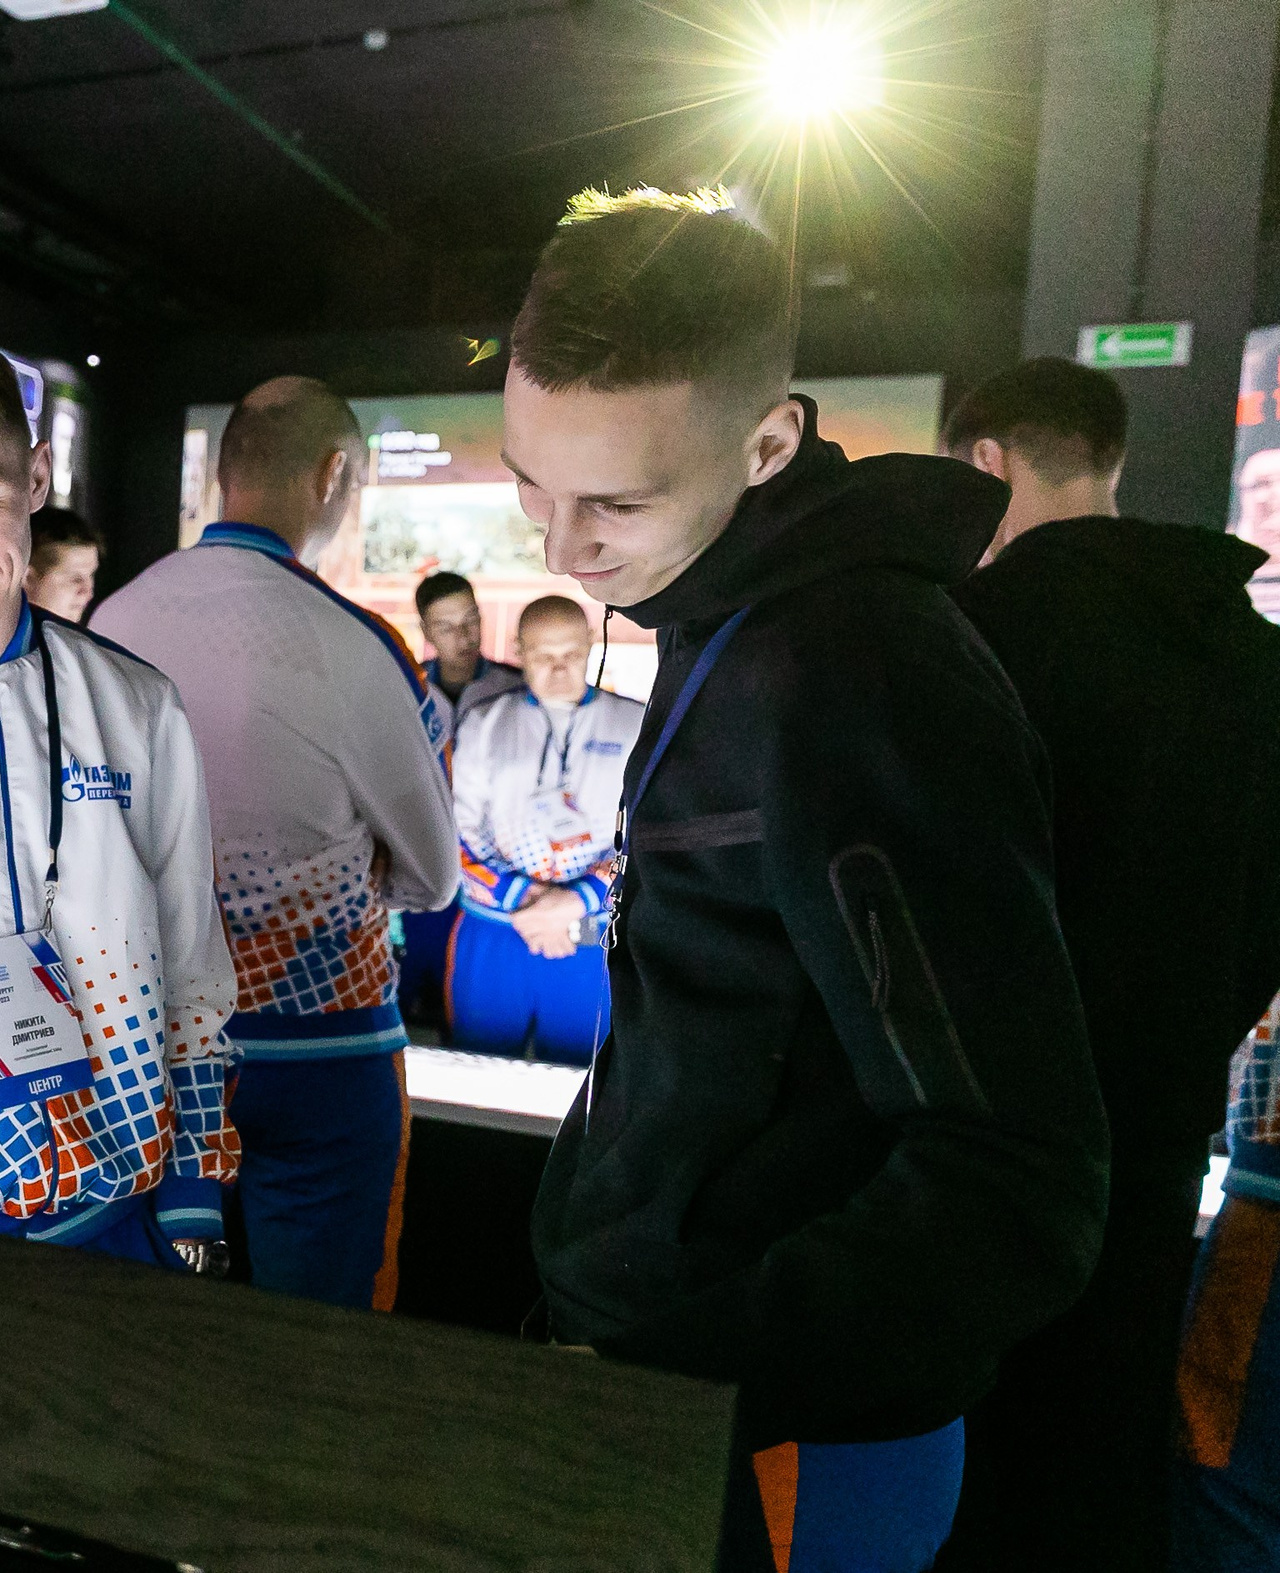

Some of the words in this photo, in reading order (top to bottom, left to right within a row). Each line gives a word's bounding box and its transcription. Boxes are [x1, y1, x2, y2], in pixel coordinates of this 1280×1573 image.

[14, 1015, 46, 1030] НИКИТА
[12, 1026, 55, 1047] ДМИТРИЕВ
[28, 1075, 63, 1095] ЦЕНТР
